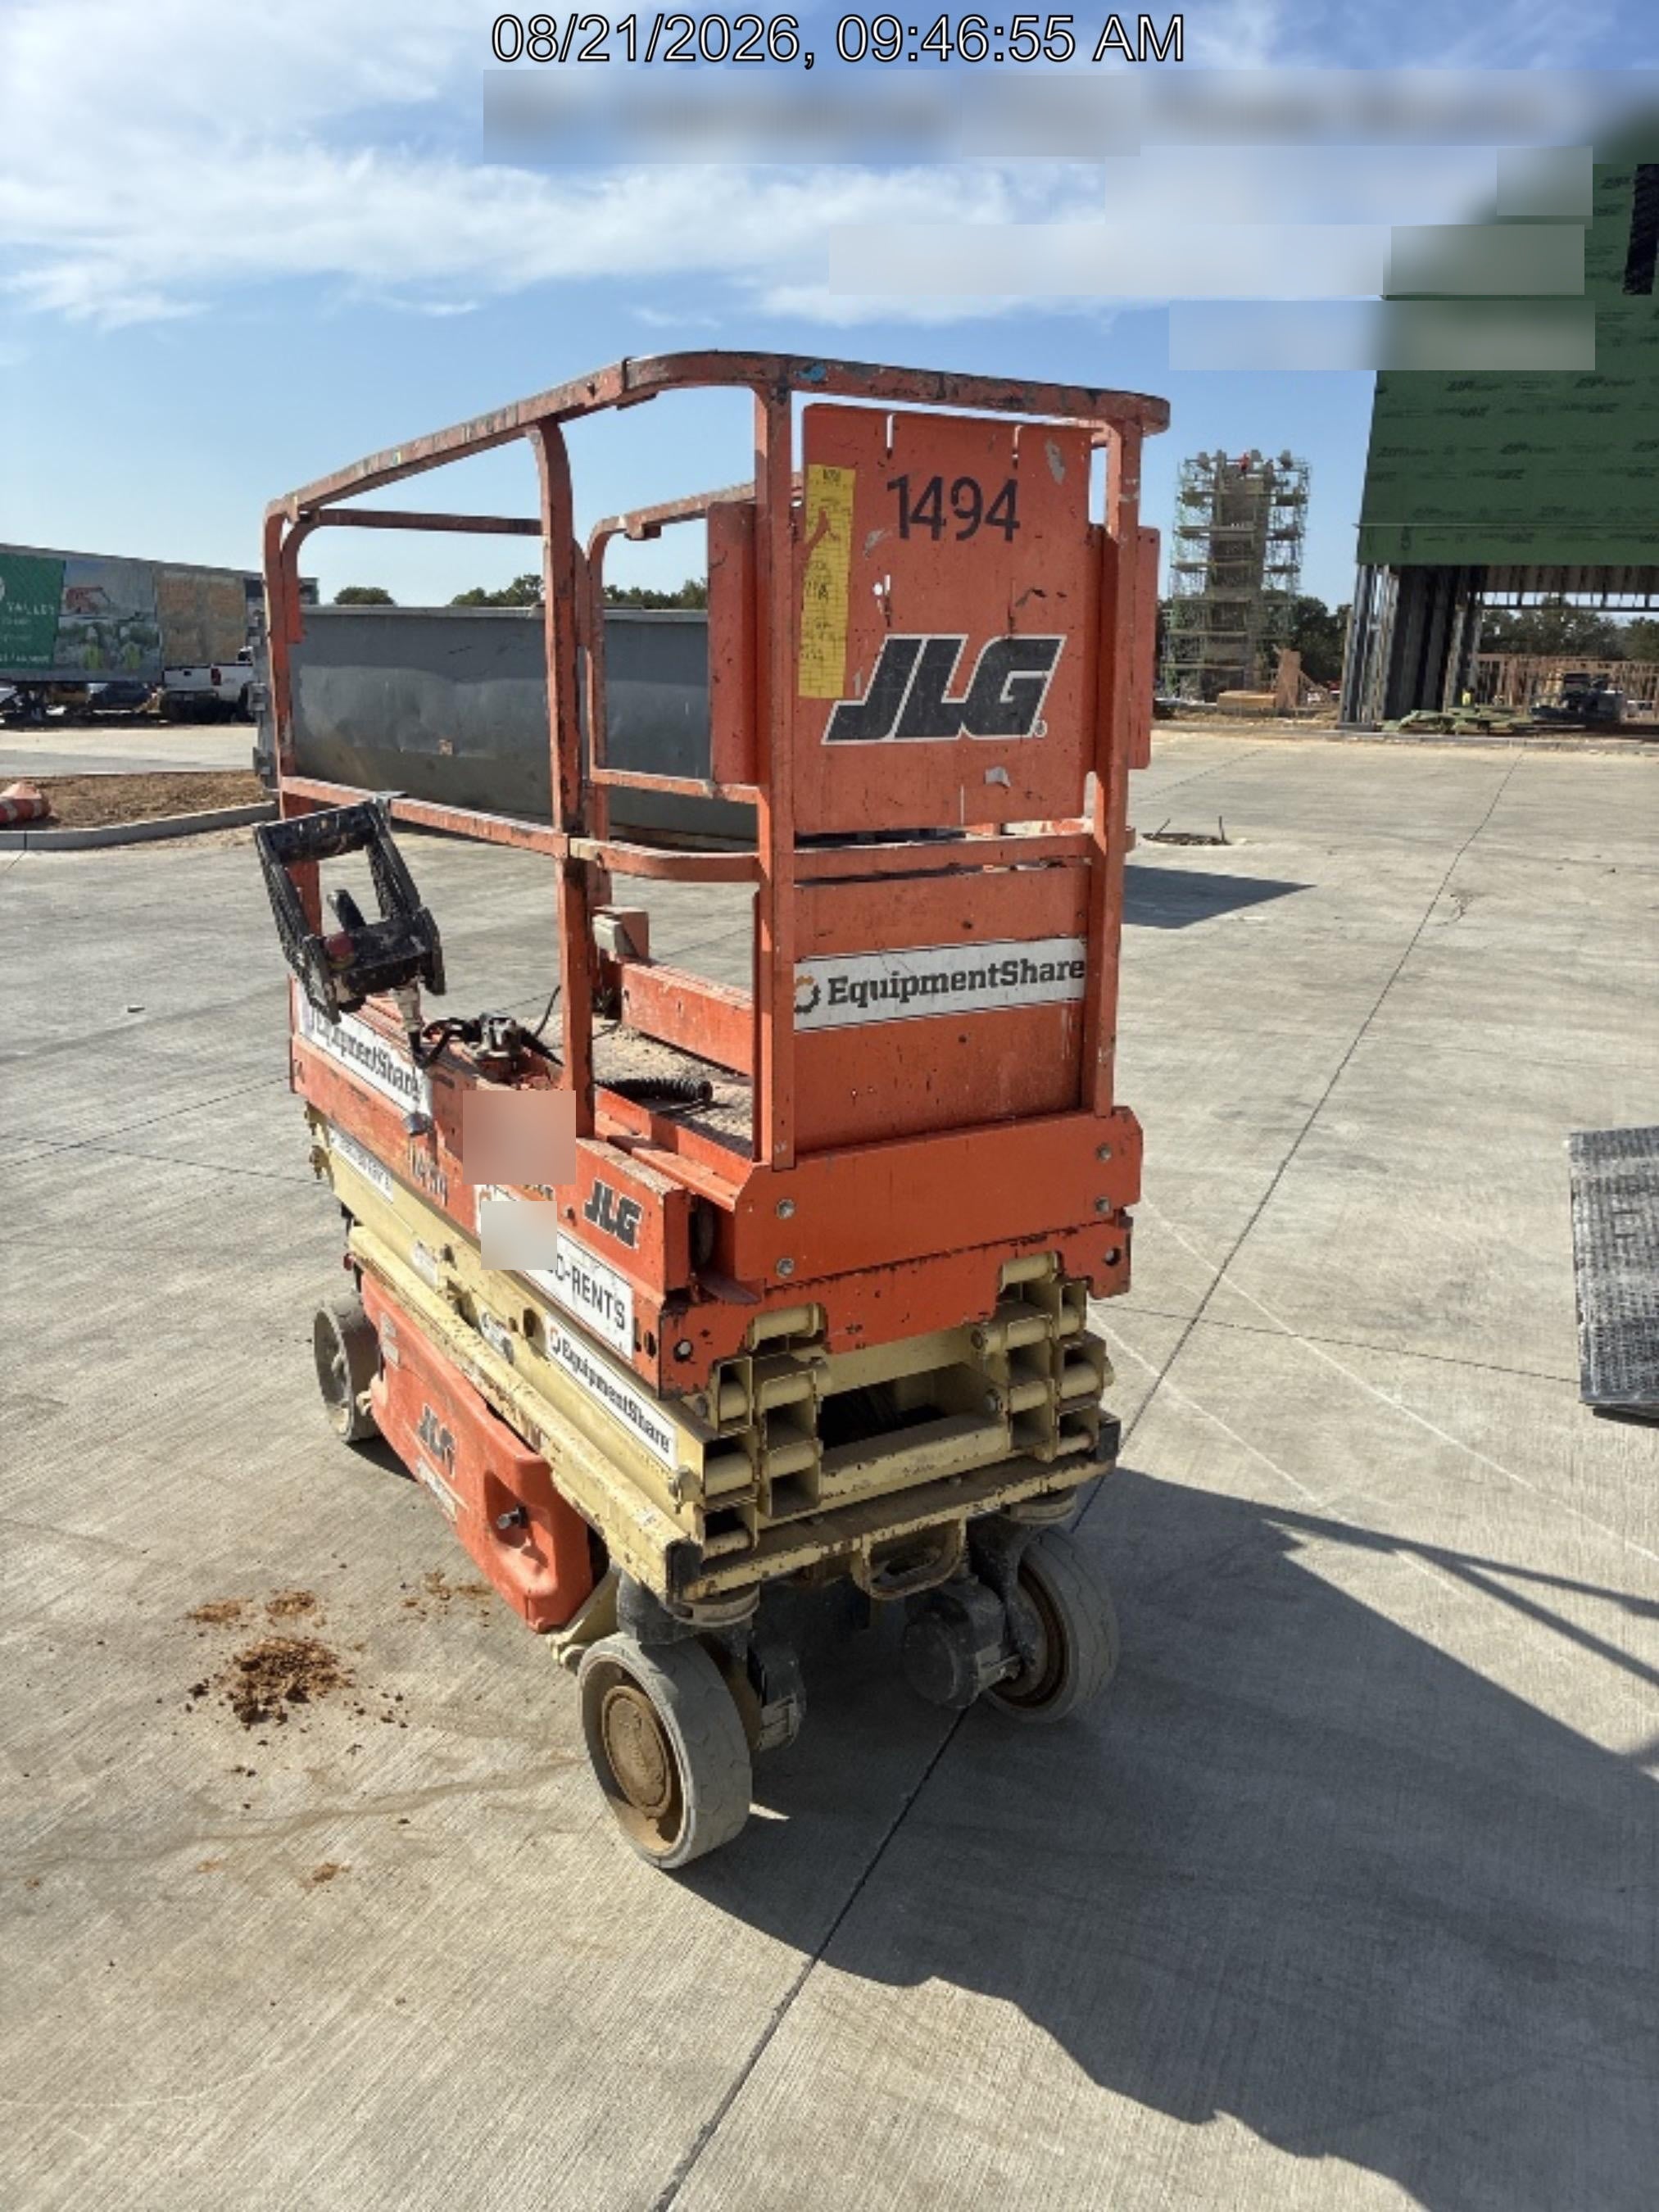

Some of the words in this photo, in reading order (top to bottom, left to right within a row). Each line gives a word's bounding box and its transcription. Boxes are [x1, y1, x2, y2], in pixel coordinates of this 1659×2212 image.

[887, 474, 1021, 542] 1494
[822, 633, 1067, 746] JLG
[827, 958, 1086, 1009] EquipmentShare
[582, 1177, 644, 1250] JLG
